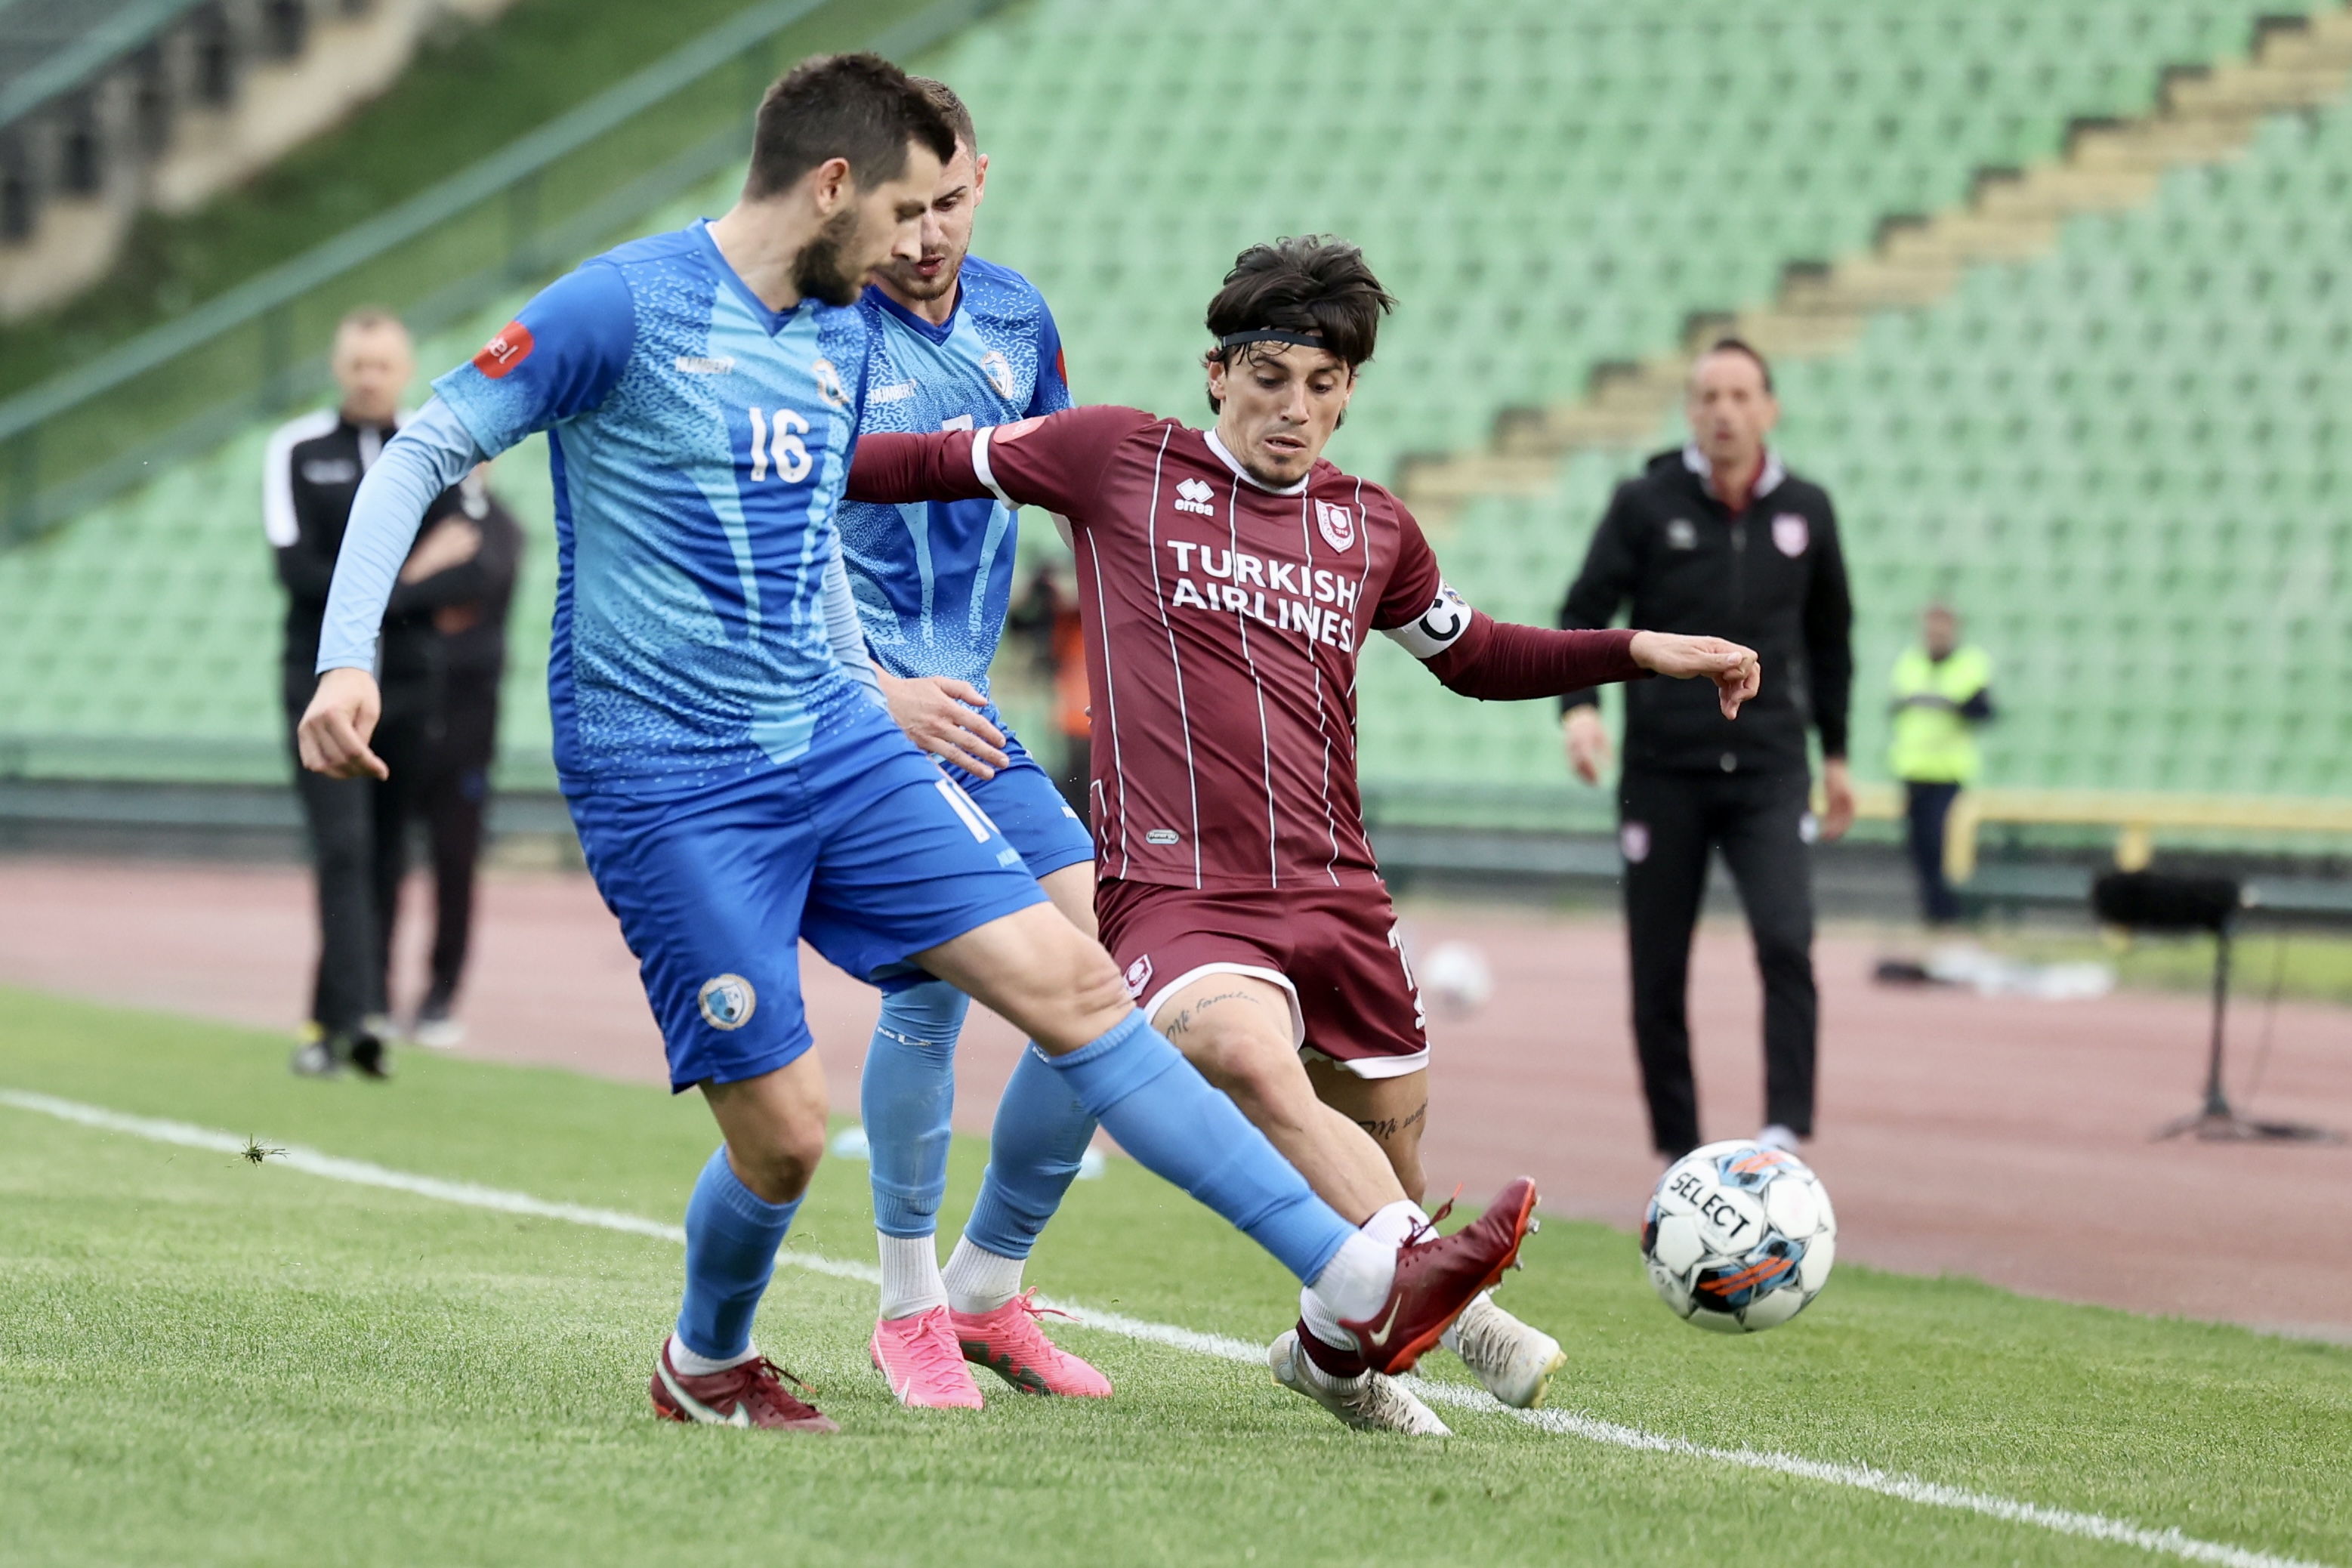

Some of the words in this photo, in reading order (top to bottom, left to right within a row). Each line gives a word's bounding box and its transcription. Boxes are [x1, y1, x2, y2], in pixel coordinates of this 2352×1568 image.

[749, 407, 813, 483] 16
[1174, 498, 1214, 517] errea
[1167, 540, 1357, 614] TURKISH
[1172, 578, 1352, 653] AIRLINES
[1418, 598, 1461, 641] C
[1670, 1172, 1750, 1238] SELECT
